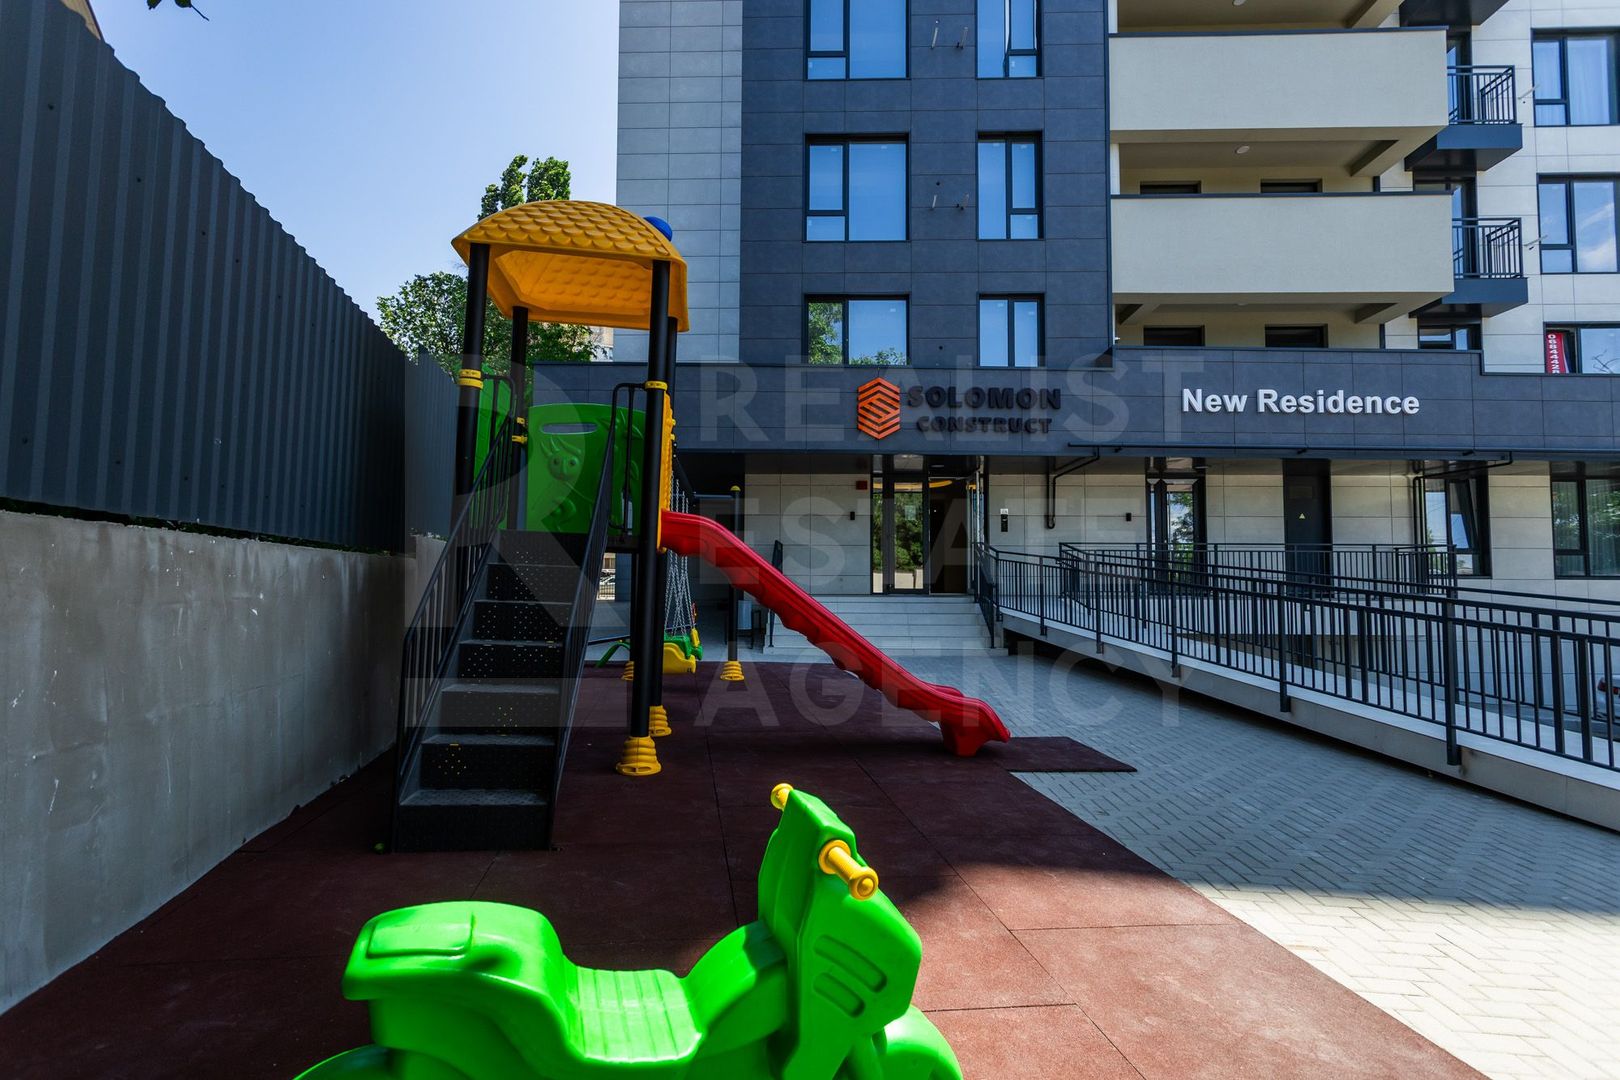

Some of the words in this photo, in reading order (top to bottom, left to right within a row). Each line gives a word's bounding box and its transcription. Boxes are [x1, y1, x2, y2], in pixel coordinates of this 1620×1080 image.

[908, 385, 1061, 410] SOLOMON
[1181, 388, 1248, 413] New
[1256, 388, 1420, 414] Residence
[917, 416, 1052, 434] CONSTRUCT
